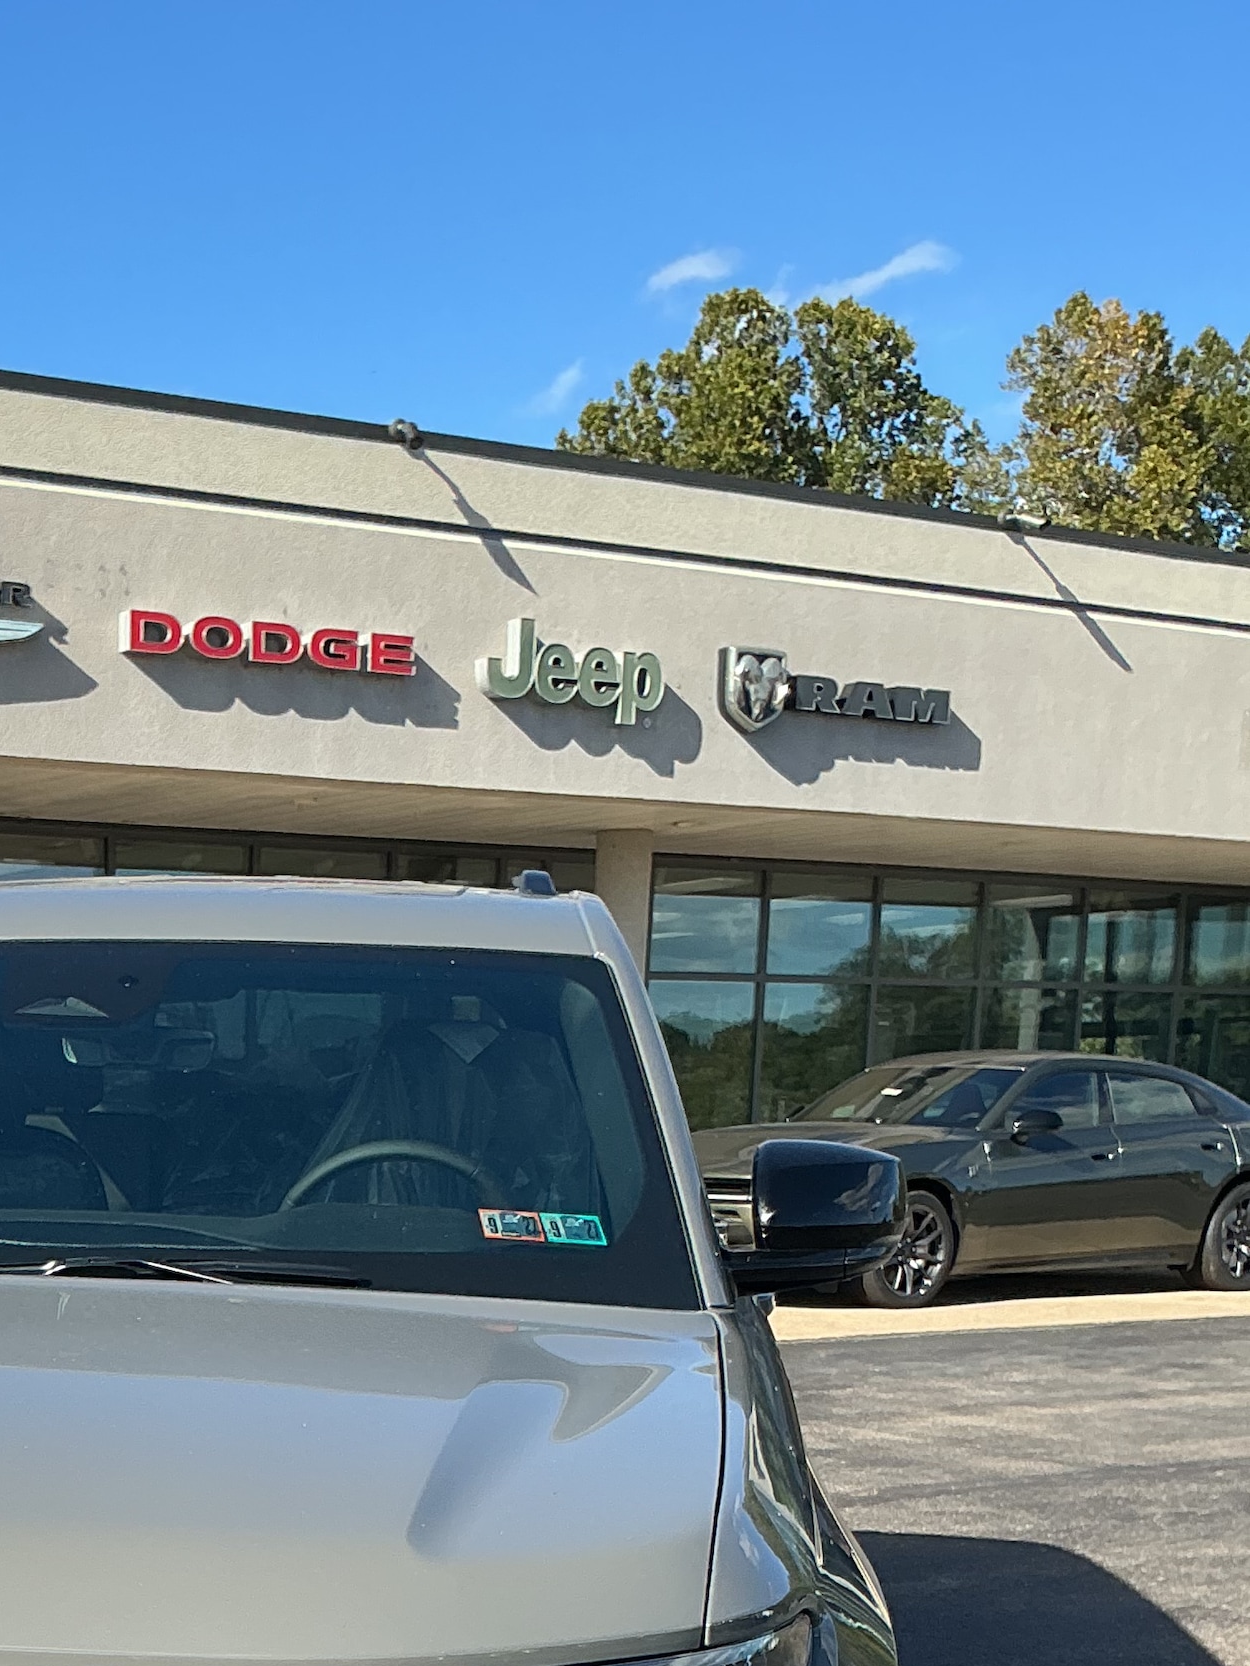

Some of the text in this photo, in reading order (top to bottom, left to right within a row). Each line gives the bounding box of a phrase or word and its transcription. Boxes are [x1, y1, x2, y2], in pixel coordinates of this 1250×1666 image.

[119, 609, 417, 676] DODGE
[475, 617, 664, 725] Jeep
[793, 674, 951, 725] RAM
